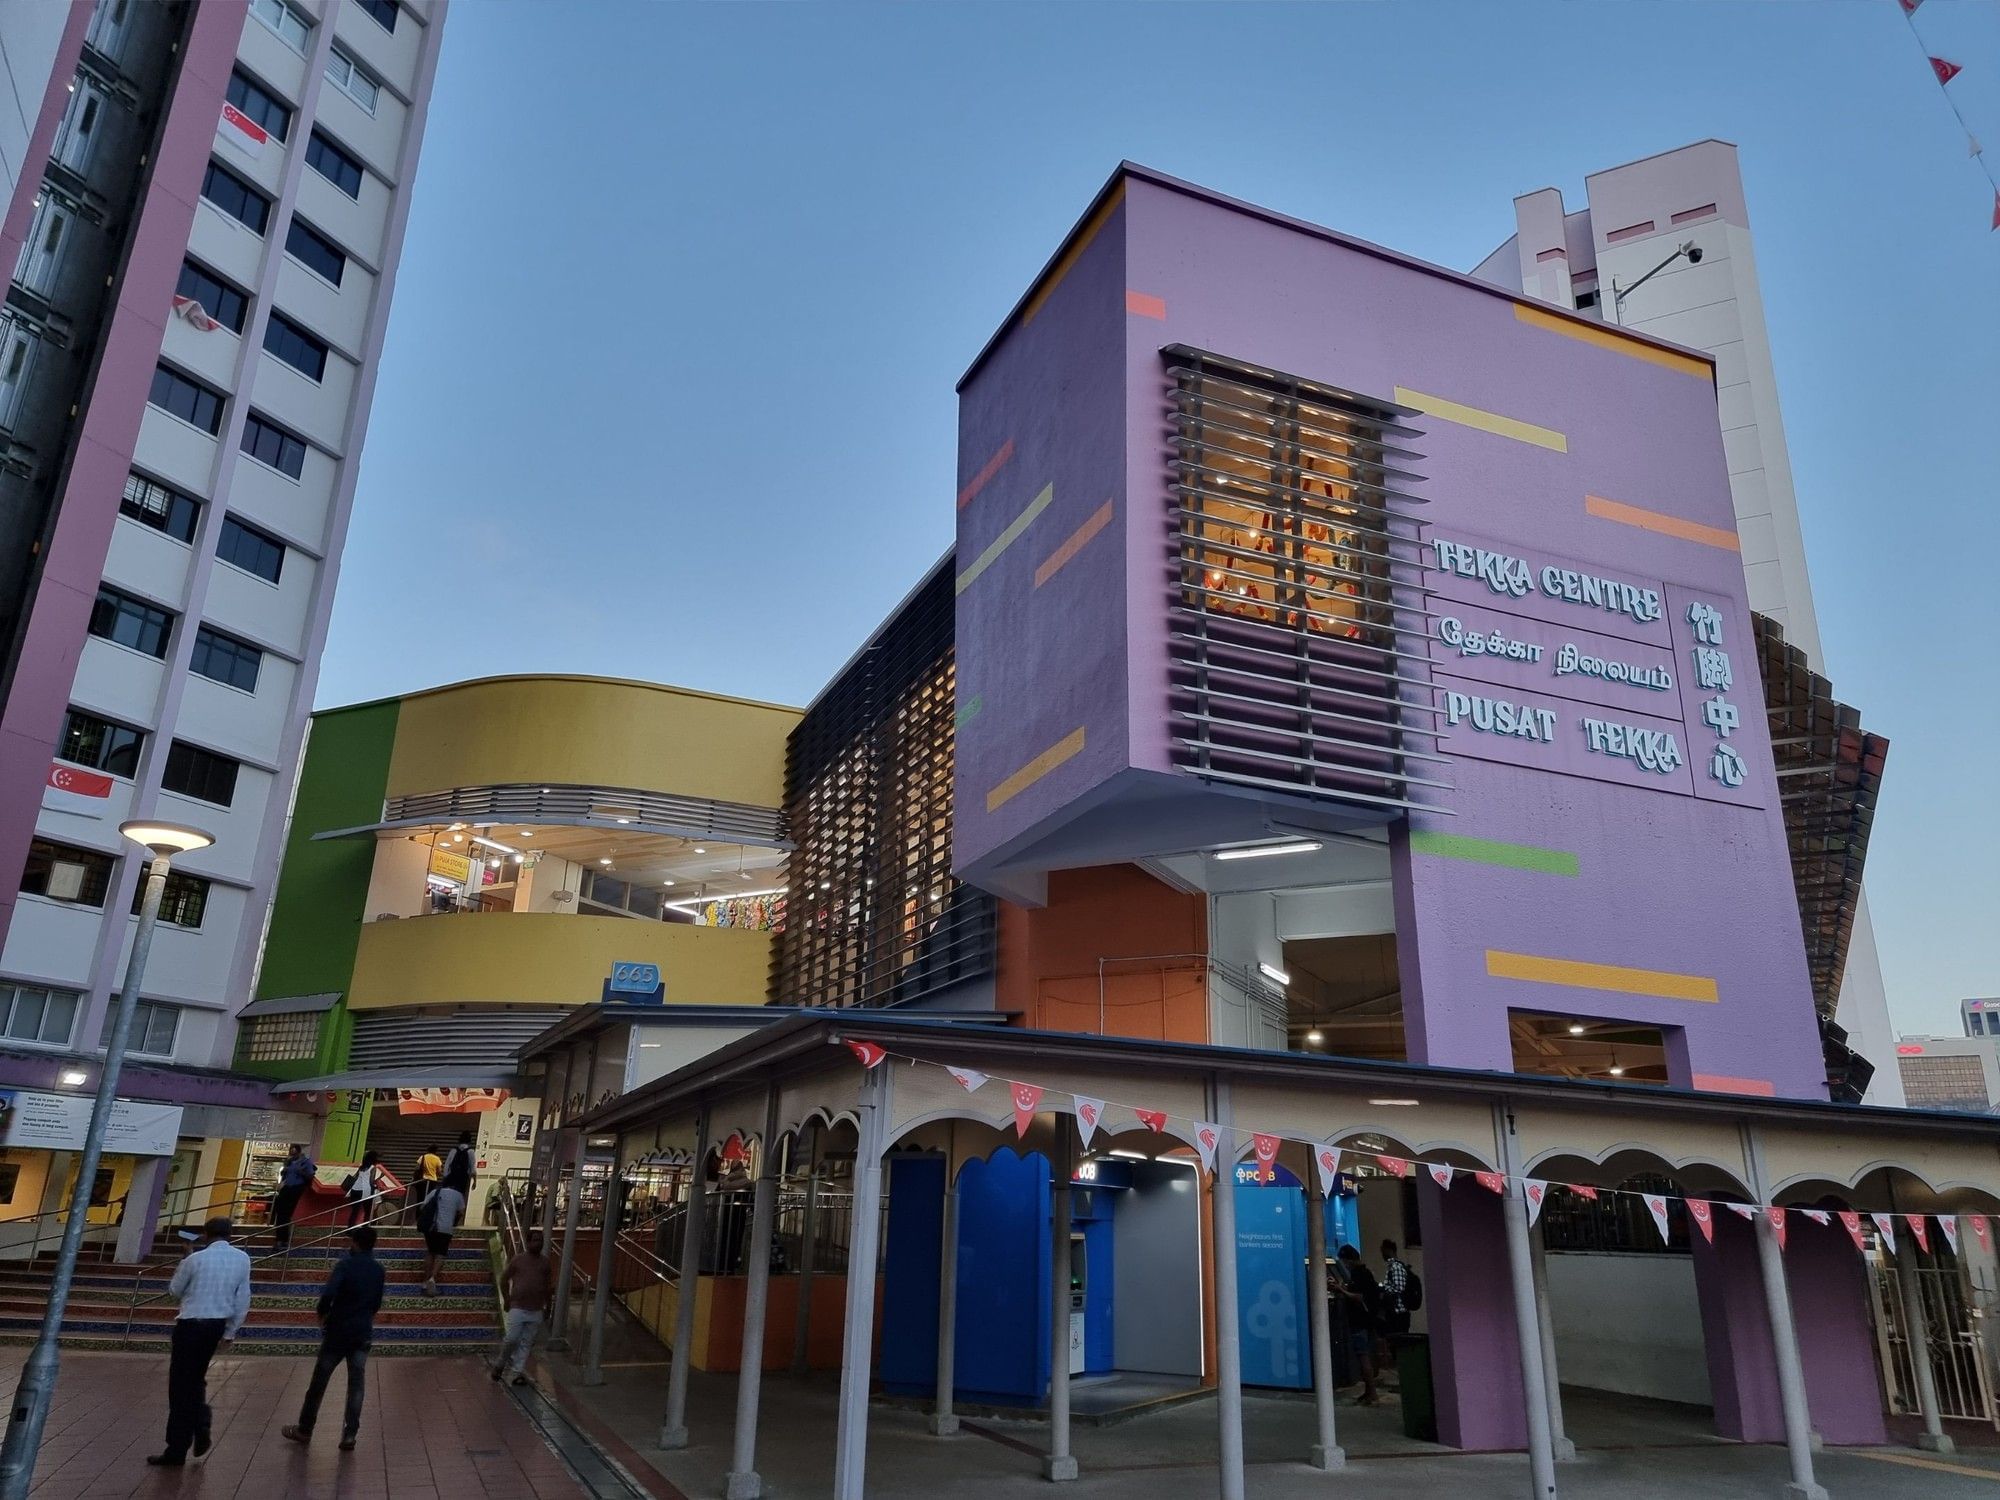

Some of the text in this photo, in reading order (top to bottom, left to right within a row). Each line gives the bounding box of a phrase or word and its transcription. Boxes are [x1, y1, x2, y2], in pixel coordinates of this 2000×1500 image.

[1432, 539, 1662, 624] TEKKA CENTRE
[1438, 616, 1673, 691] தேக்கா நிலையம்
[1445, 690, 1683, 774] PUSAT TEKKA
[1687, 601, 1748, 788] 竹脚中心
[616, 965, 653, 982] 665
[1079, 1164, 1095, 1179] UOB
